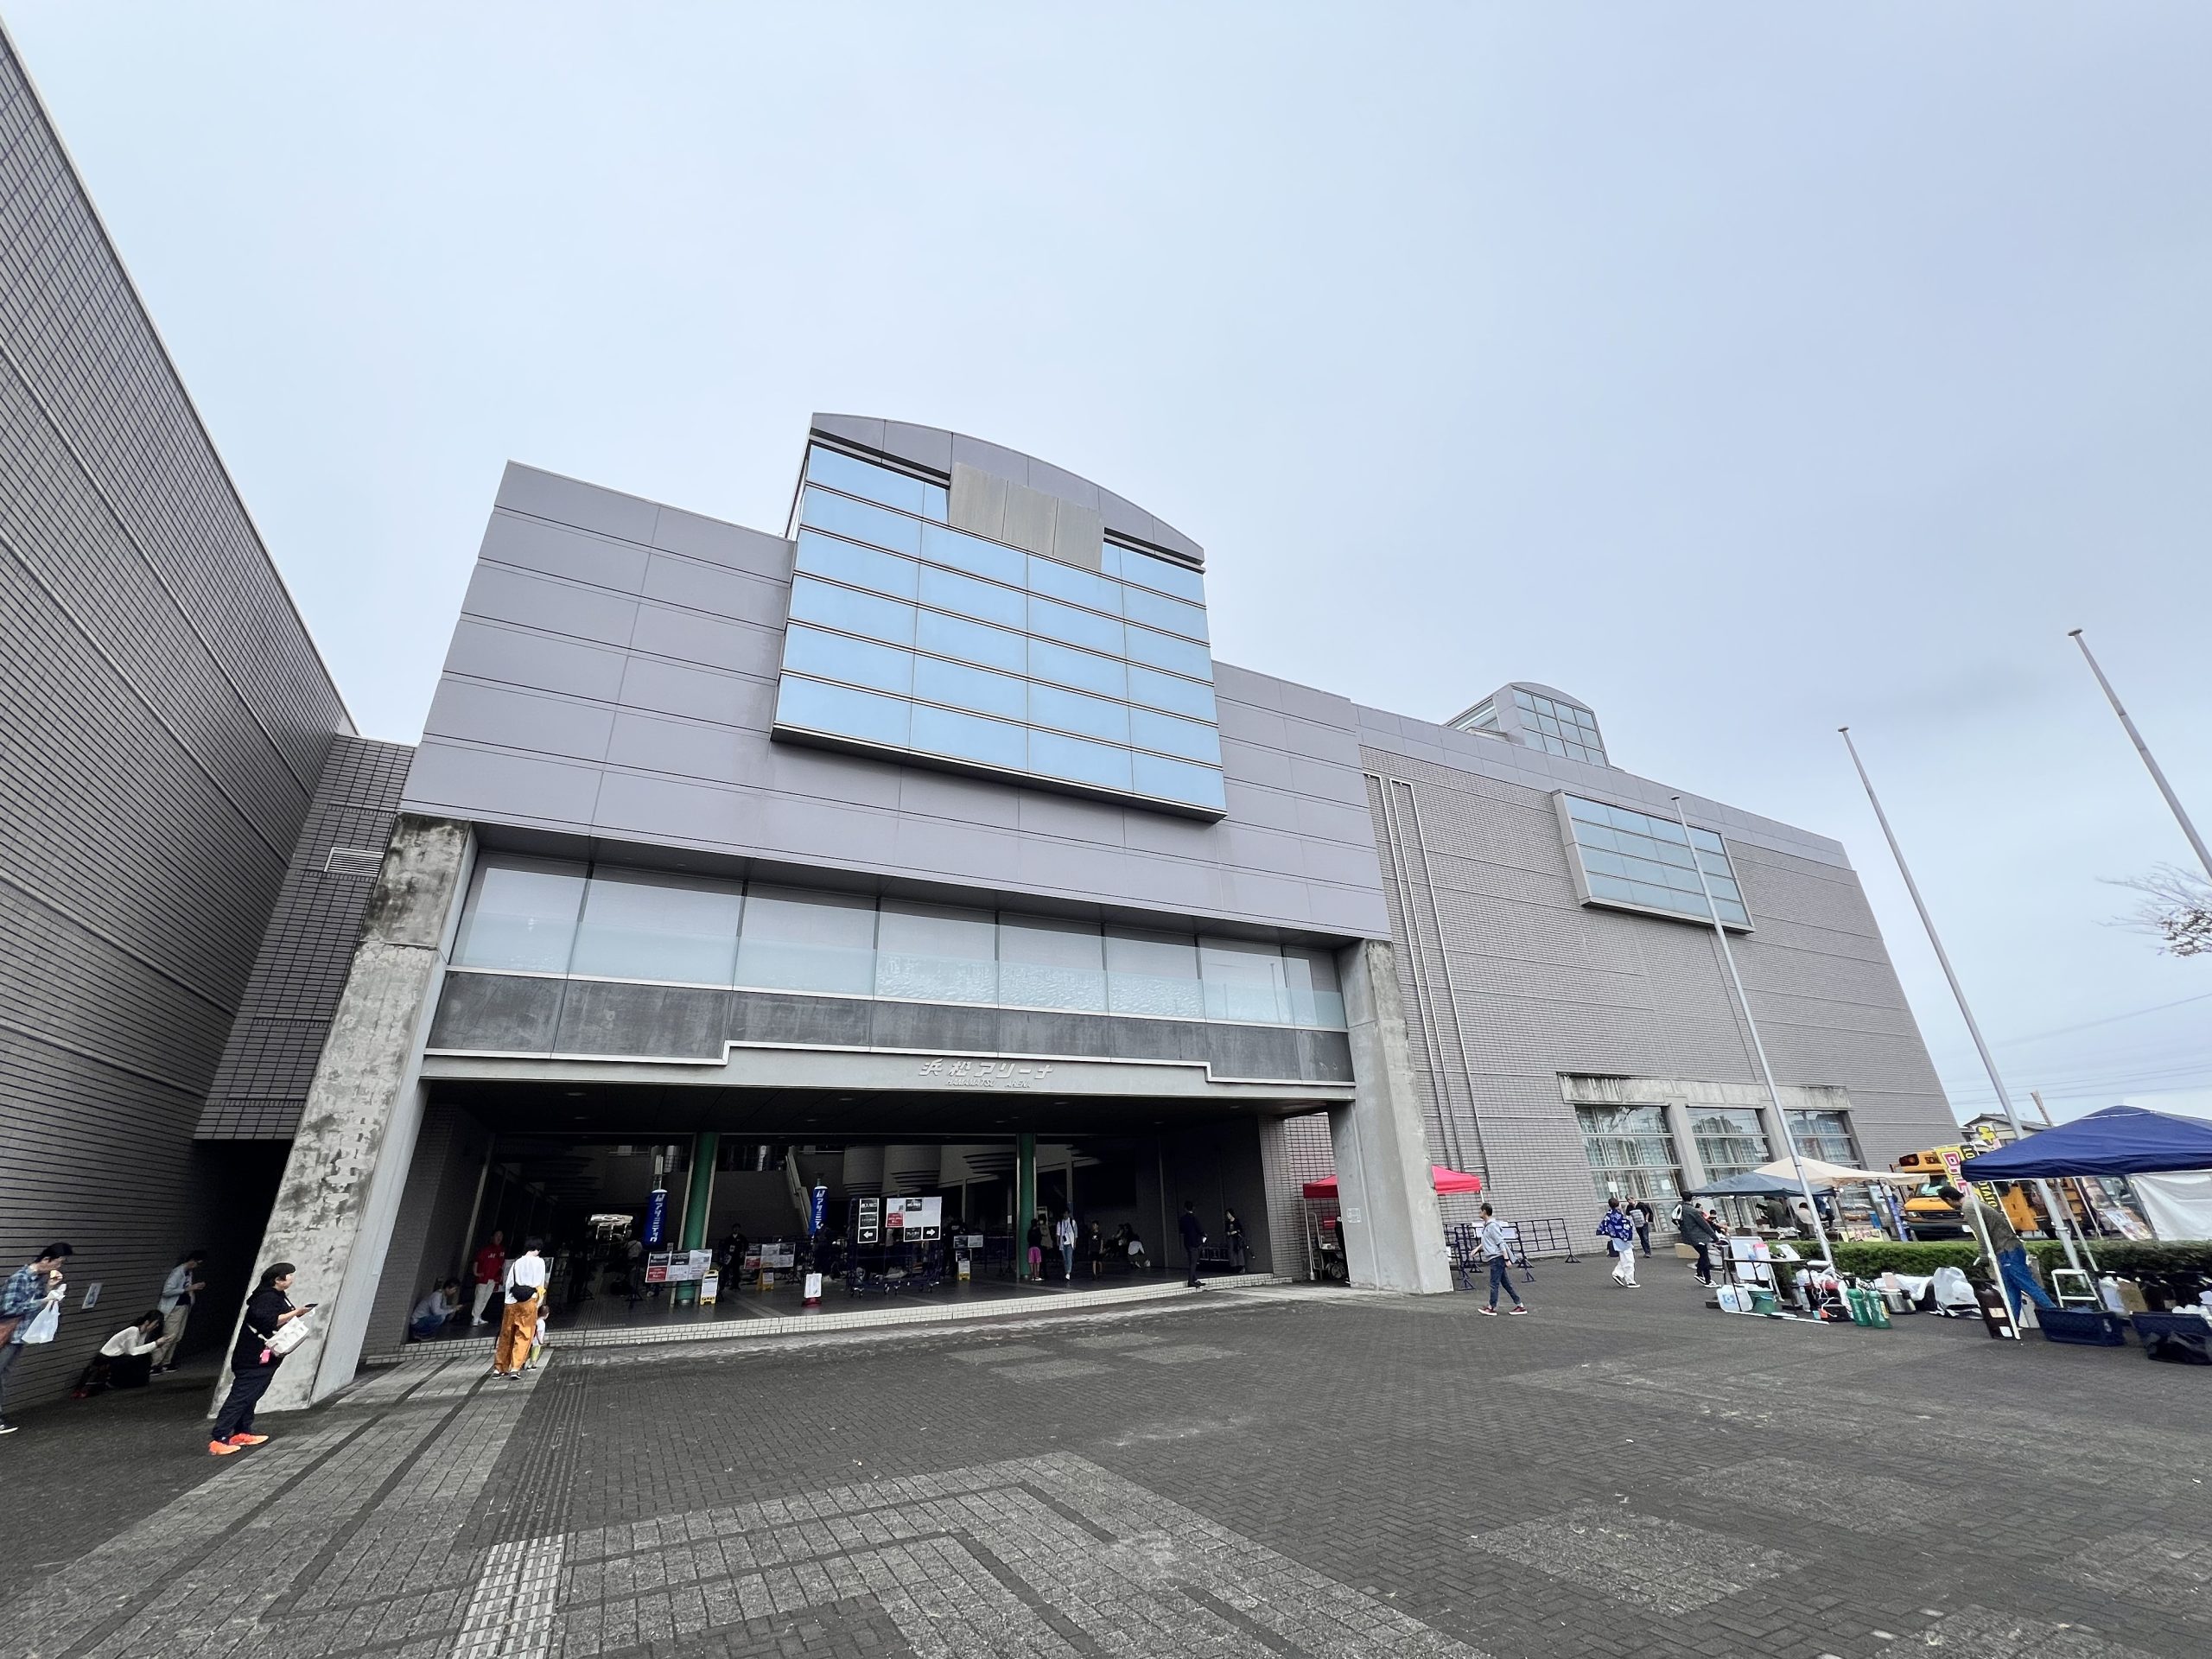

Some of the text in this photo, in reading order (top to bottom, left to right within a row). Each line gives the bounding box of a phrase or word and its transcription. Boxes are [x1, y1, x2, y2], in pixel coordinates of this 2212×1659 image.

[919, 1058, 1053, 1079] 浜松アリーナ
[946, 1078, 995, 1088] HAMAMATSU
